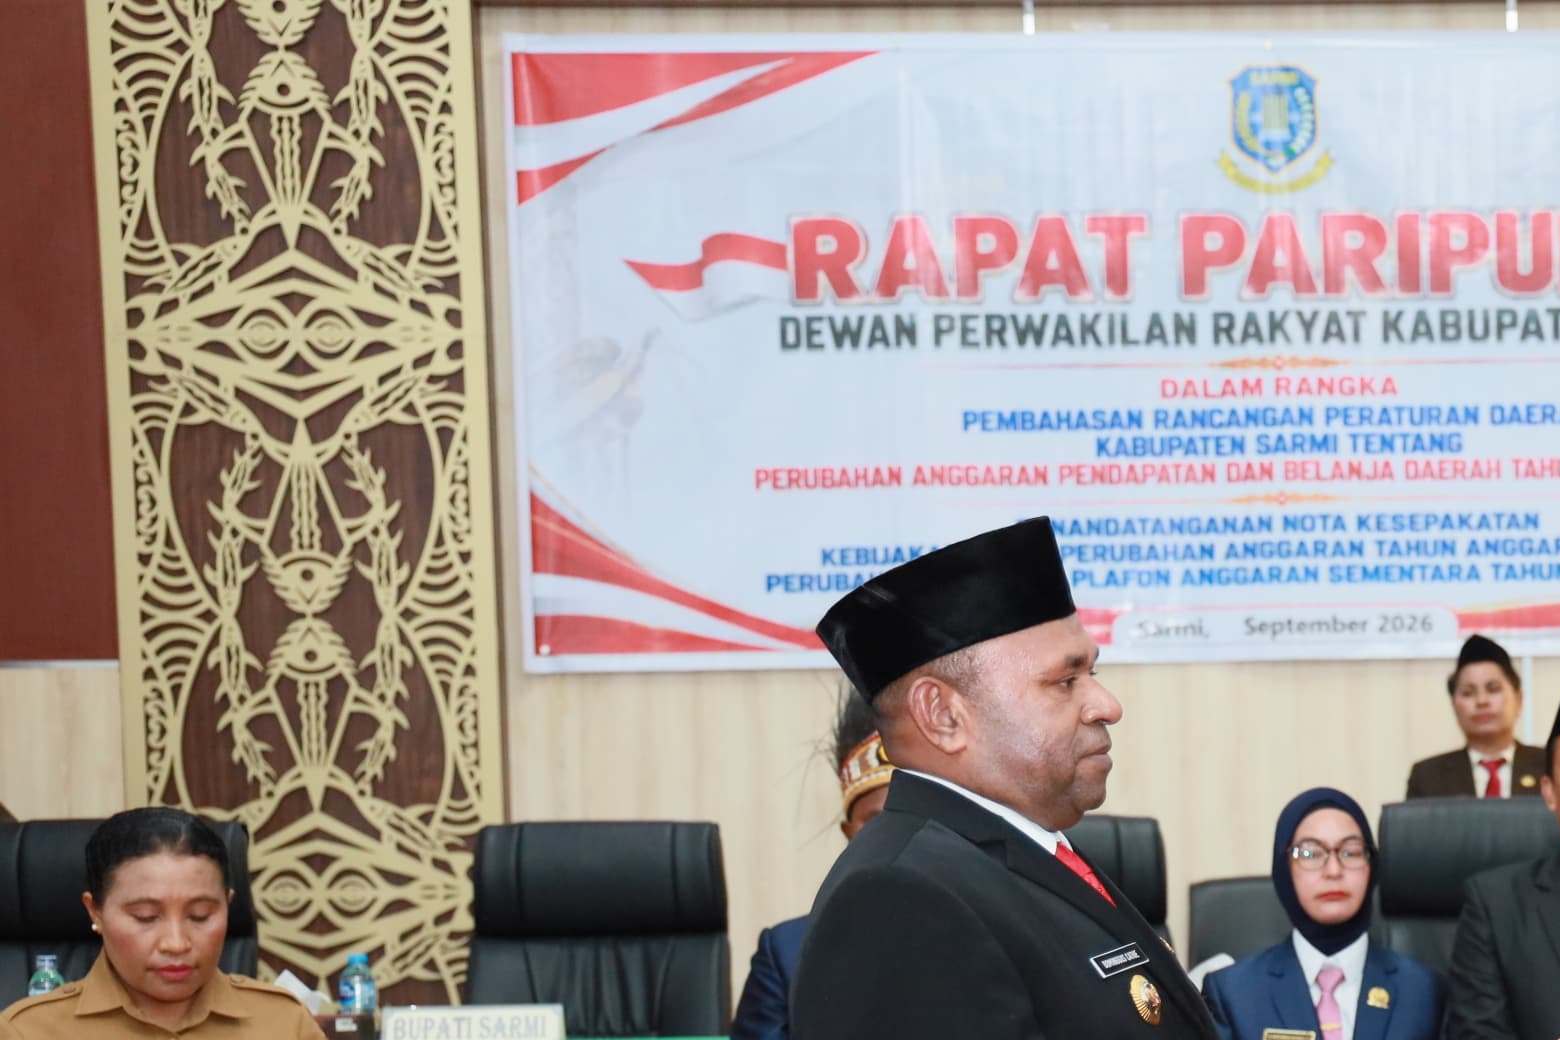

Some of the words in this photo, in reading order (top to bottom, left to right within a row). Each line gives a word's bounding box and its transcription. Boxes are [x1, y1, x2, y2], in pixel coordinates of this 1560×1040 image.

[791, 211, 1151, 303] RAPAT
[780, 314, 919, 352] DEWAN
[932, 310, 1198, 350] PERWAKILAN
[1213, 309, 1366, 346] RAKYAT
[1160, 378, 1264, 399] DALAM
[1274, 375, 1399, 397] RANGKA
[962, 408, 1143, 432] PEMBAHASAN
[1153, 406, 1315, 430] RANCANGAN
[1325, 404, 1480, 427] PERATURAN
[1096, 435, 1246, 457] KABUPATEN
[1255, 433, 1340, 455] SARMI
[1350, 433, 1463, 454] TENTANG
[755, 466, 903, 490] PERUBAHAN
[912, 464, 1049, 488] ANGGARAN
[1058, 462, 1217, 487] PENDAPATAN
[1226, 460, 1274, 483] DAN
[1283, 459, 1395, 482] BELANJA
[1404, 458, 1502, 482] DAERAH
[1051, 515, 1273, 536] NANDATANGANAN
[1282, 514, 1347, 532] NOTA
[1356, 512, 1540, 532] KESEPAKATAN
[1060, 544, 1215, 563] PERUBAHAN
[1224, 541, 1365, 560] ANGGARAN
[1375, 539, 1457, 558] TAHUN
[1072, 569, 1172, 588] PLAFON
[1180, 566, 1319, 585] ANGGARAN
[1328, 563, 1482, 584] SEMENTARA
[1244, 613, 1368, 640] September
[1378, 614, 1433, 633] 2026
[393, 1016, 472, 1040] BUPATI
[479, 1015, 547, 1038] SARMI
